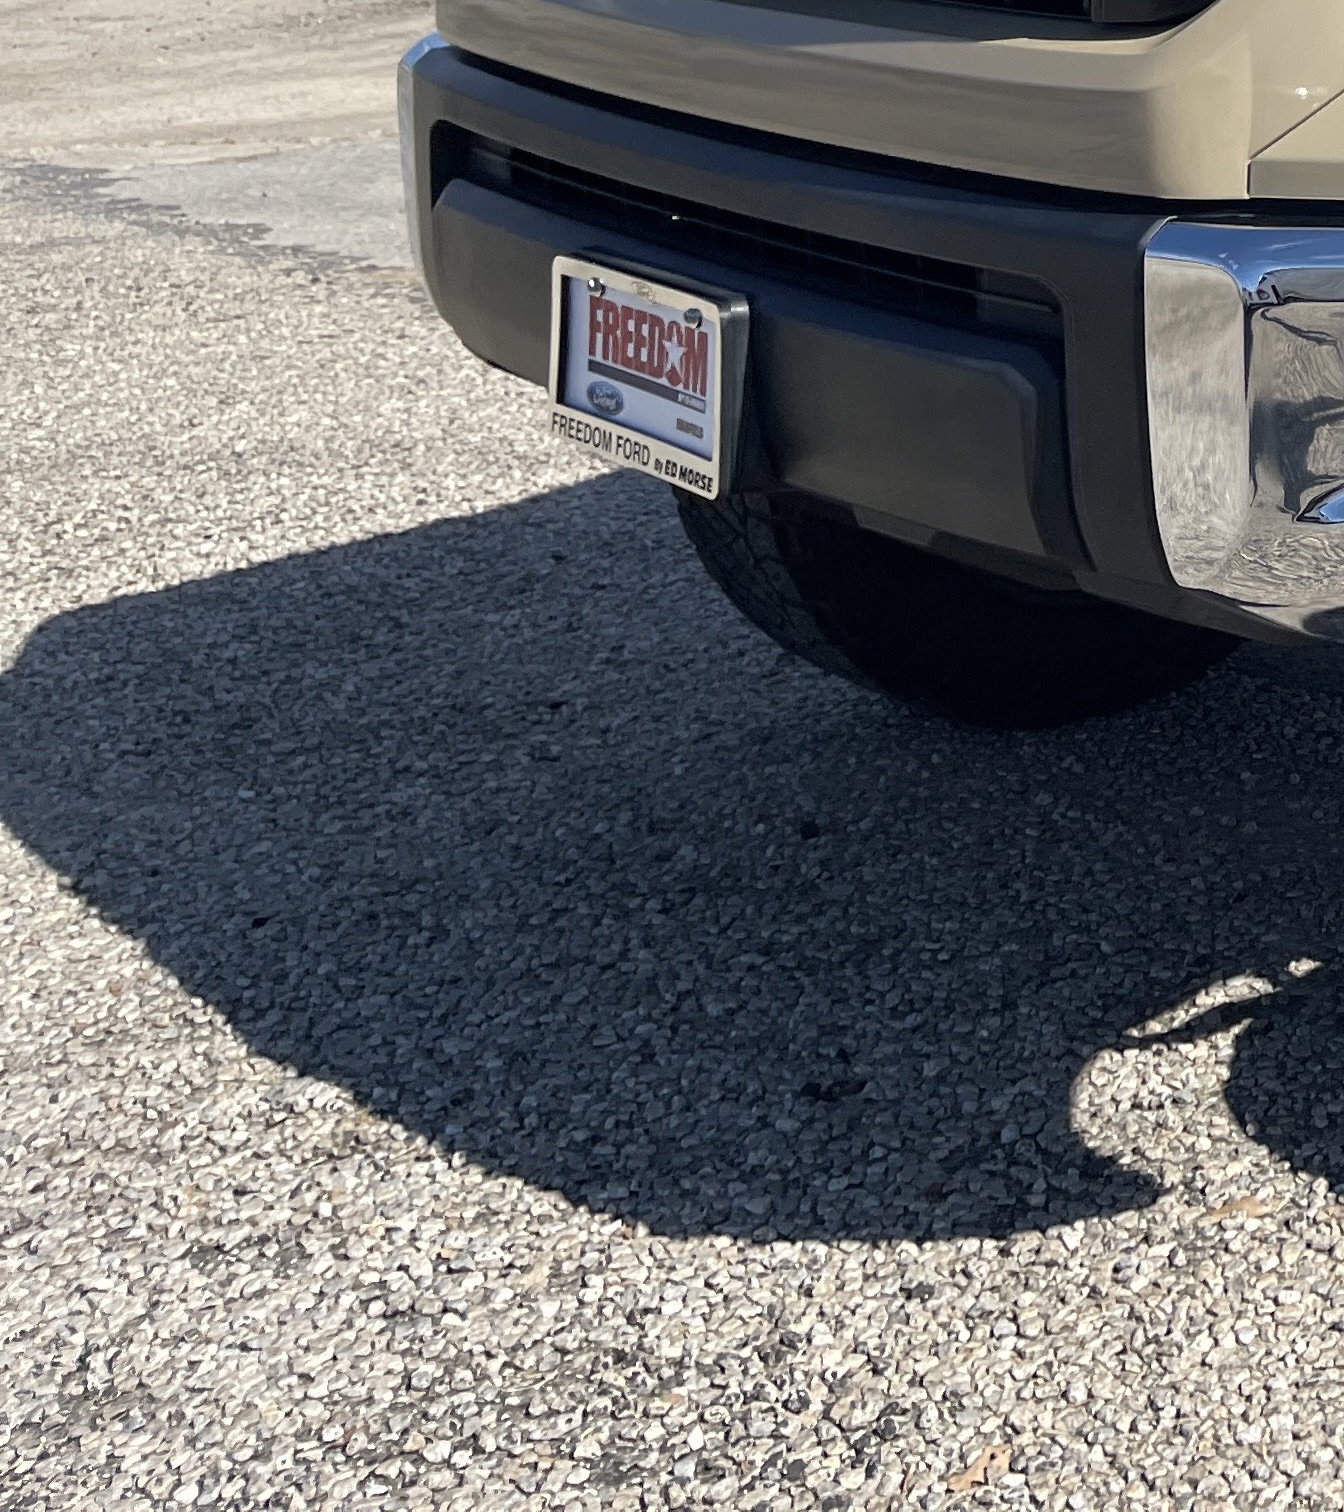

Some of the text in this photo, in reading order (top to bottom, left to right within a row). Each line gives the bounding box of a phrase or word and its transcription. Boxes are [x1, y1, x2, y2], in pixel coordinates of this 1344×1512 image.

[588, 294, 708, 397] FREEDOM
[551, 411, 612, 454] FREEDOM
[615, 434, 651, 467] FORD
[664, 459, 678, 478] ED
[678, 464, 714, 493] MORSE
